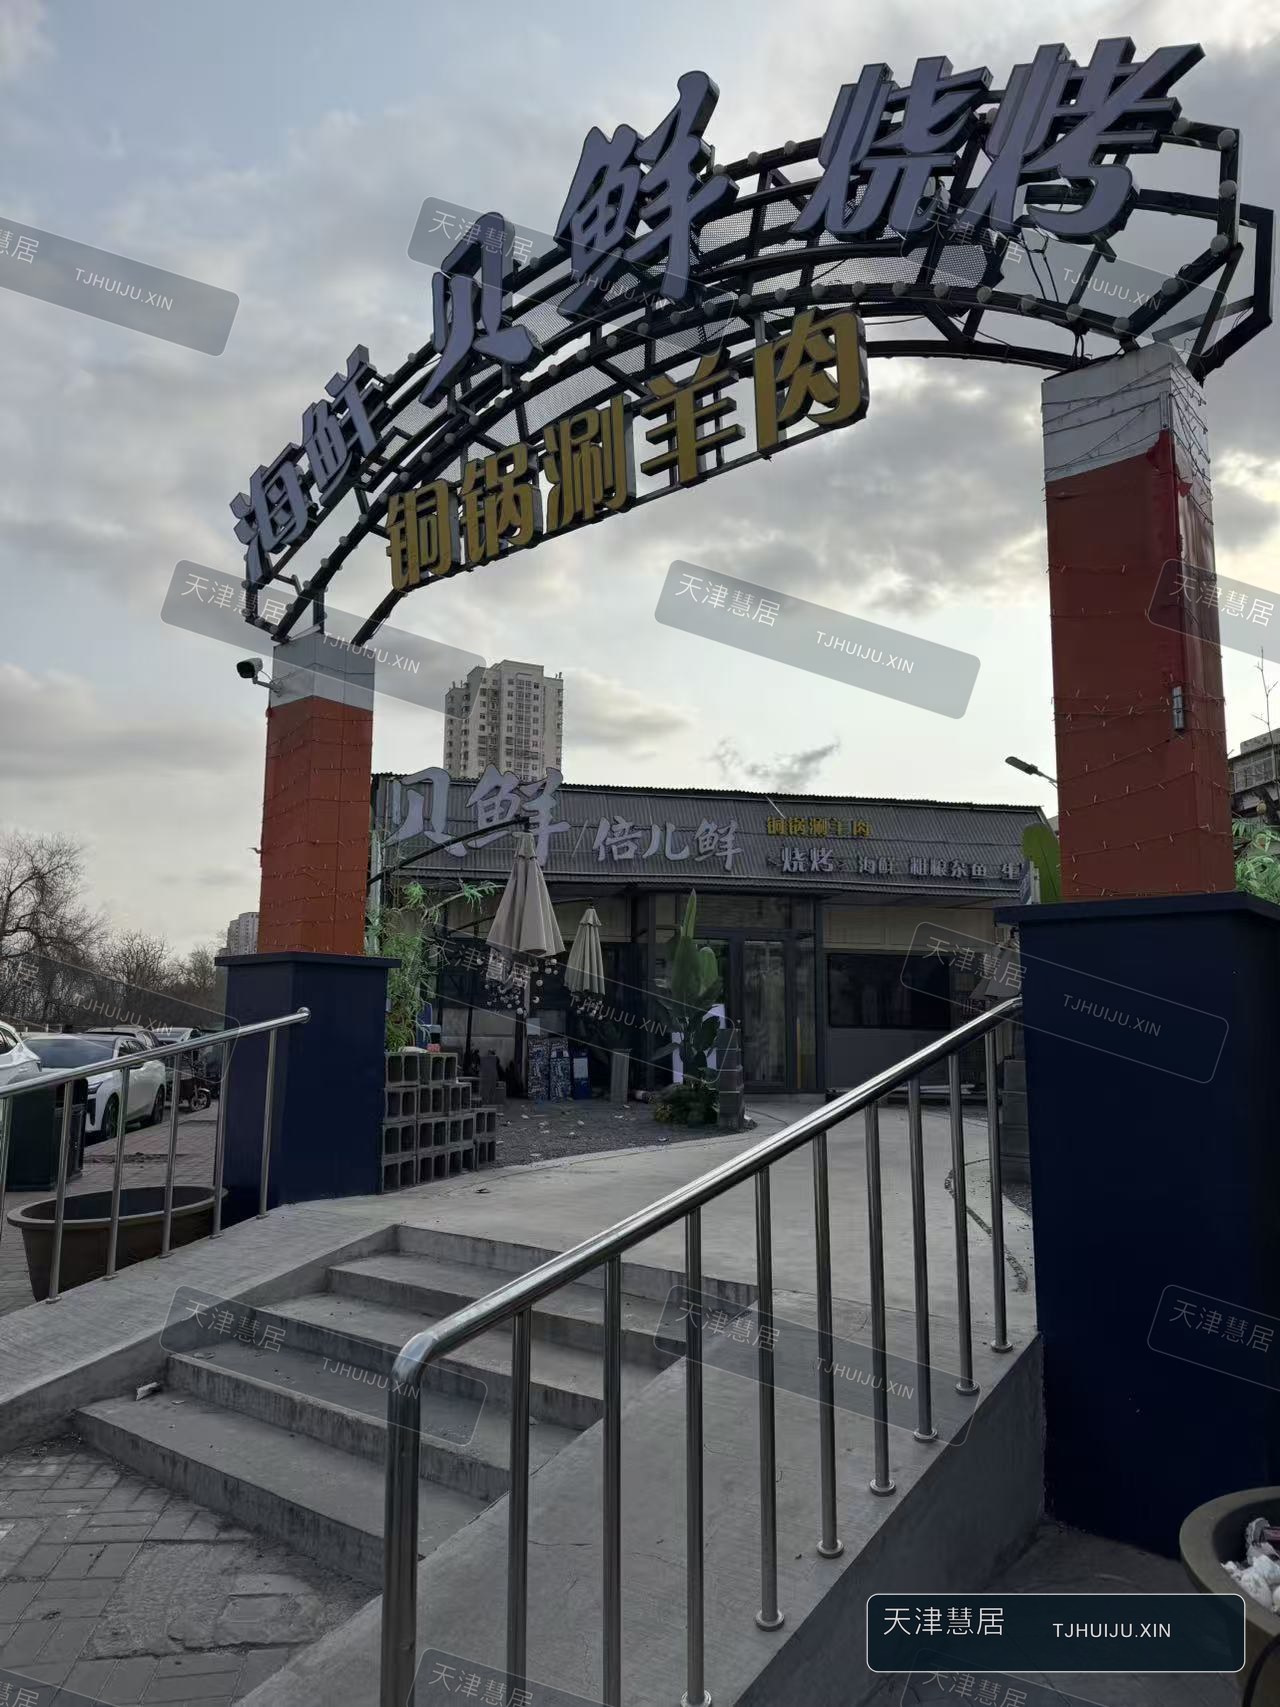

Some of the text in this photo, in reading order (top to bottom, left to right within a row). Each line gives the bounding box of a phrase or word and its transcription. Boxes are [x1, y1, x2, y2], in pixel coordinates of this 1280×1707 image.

[796, 37, 1205, 242] 烧烤
[385, 307, 869, 591] 铜锅涮羊肉
[780, 846, 833, 873] 烧烤
